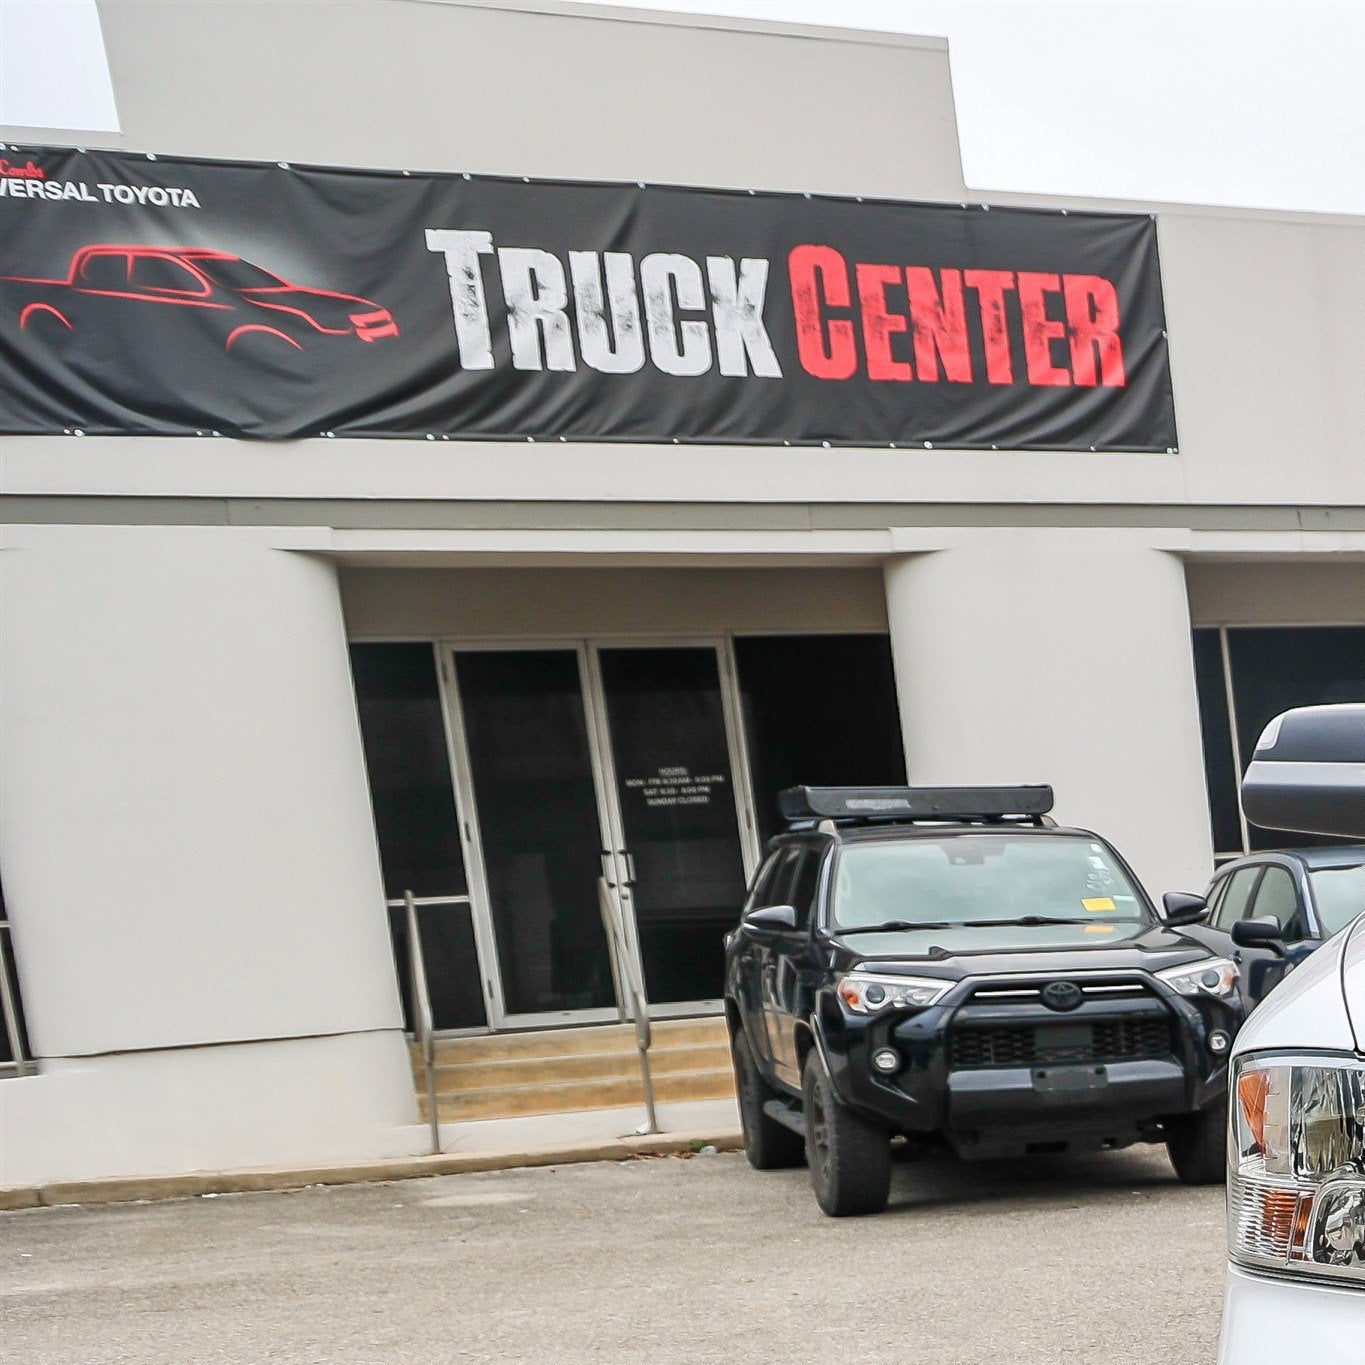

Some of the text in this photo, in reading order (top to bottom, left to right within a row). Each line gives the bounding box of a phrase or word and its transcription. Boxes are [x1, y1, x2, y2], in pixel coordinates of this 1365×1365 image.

[97, 183, 201, 208] TOYOTA
[424, 228, 1126, 388] TRUCK CENTER
